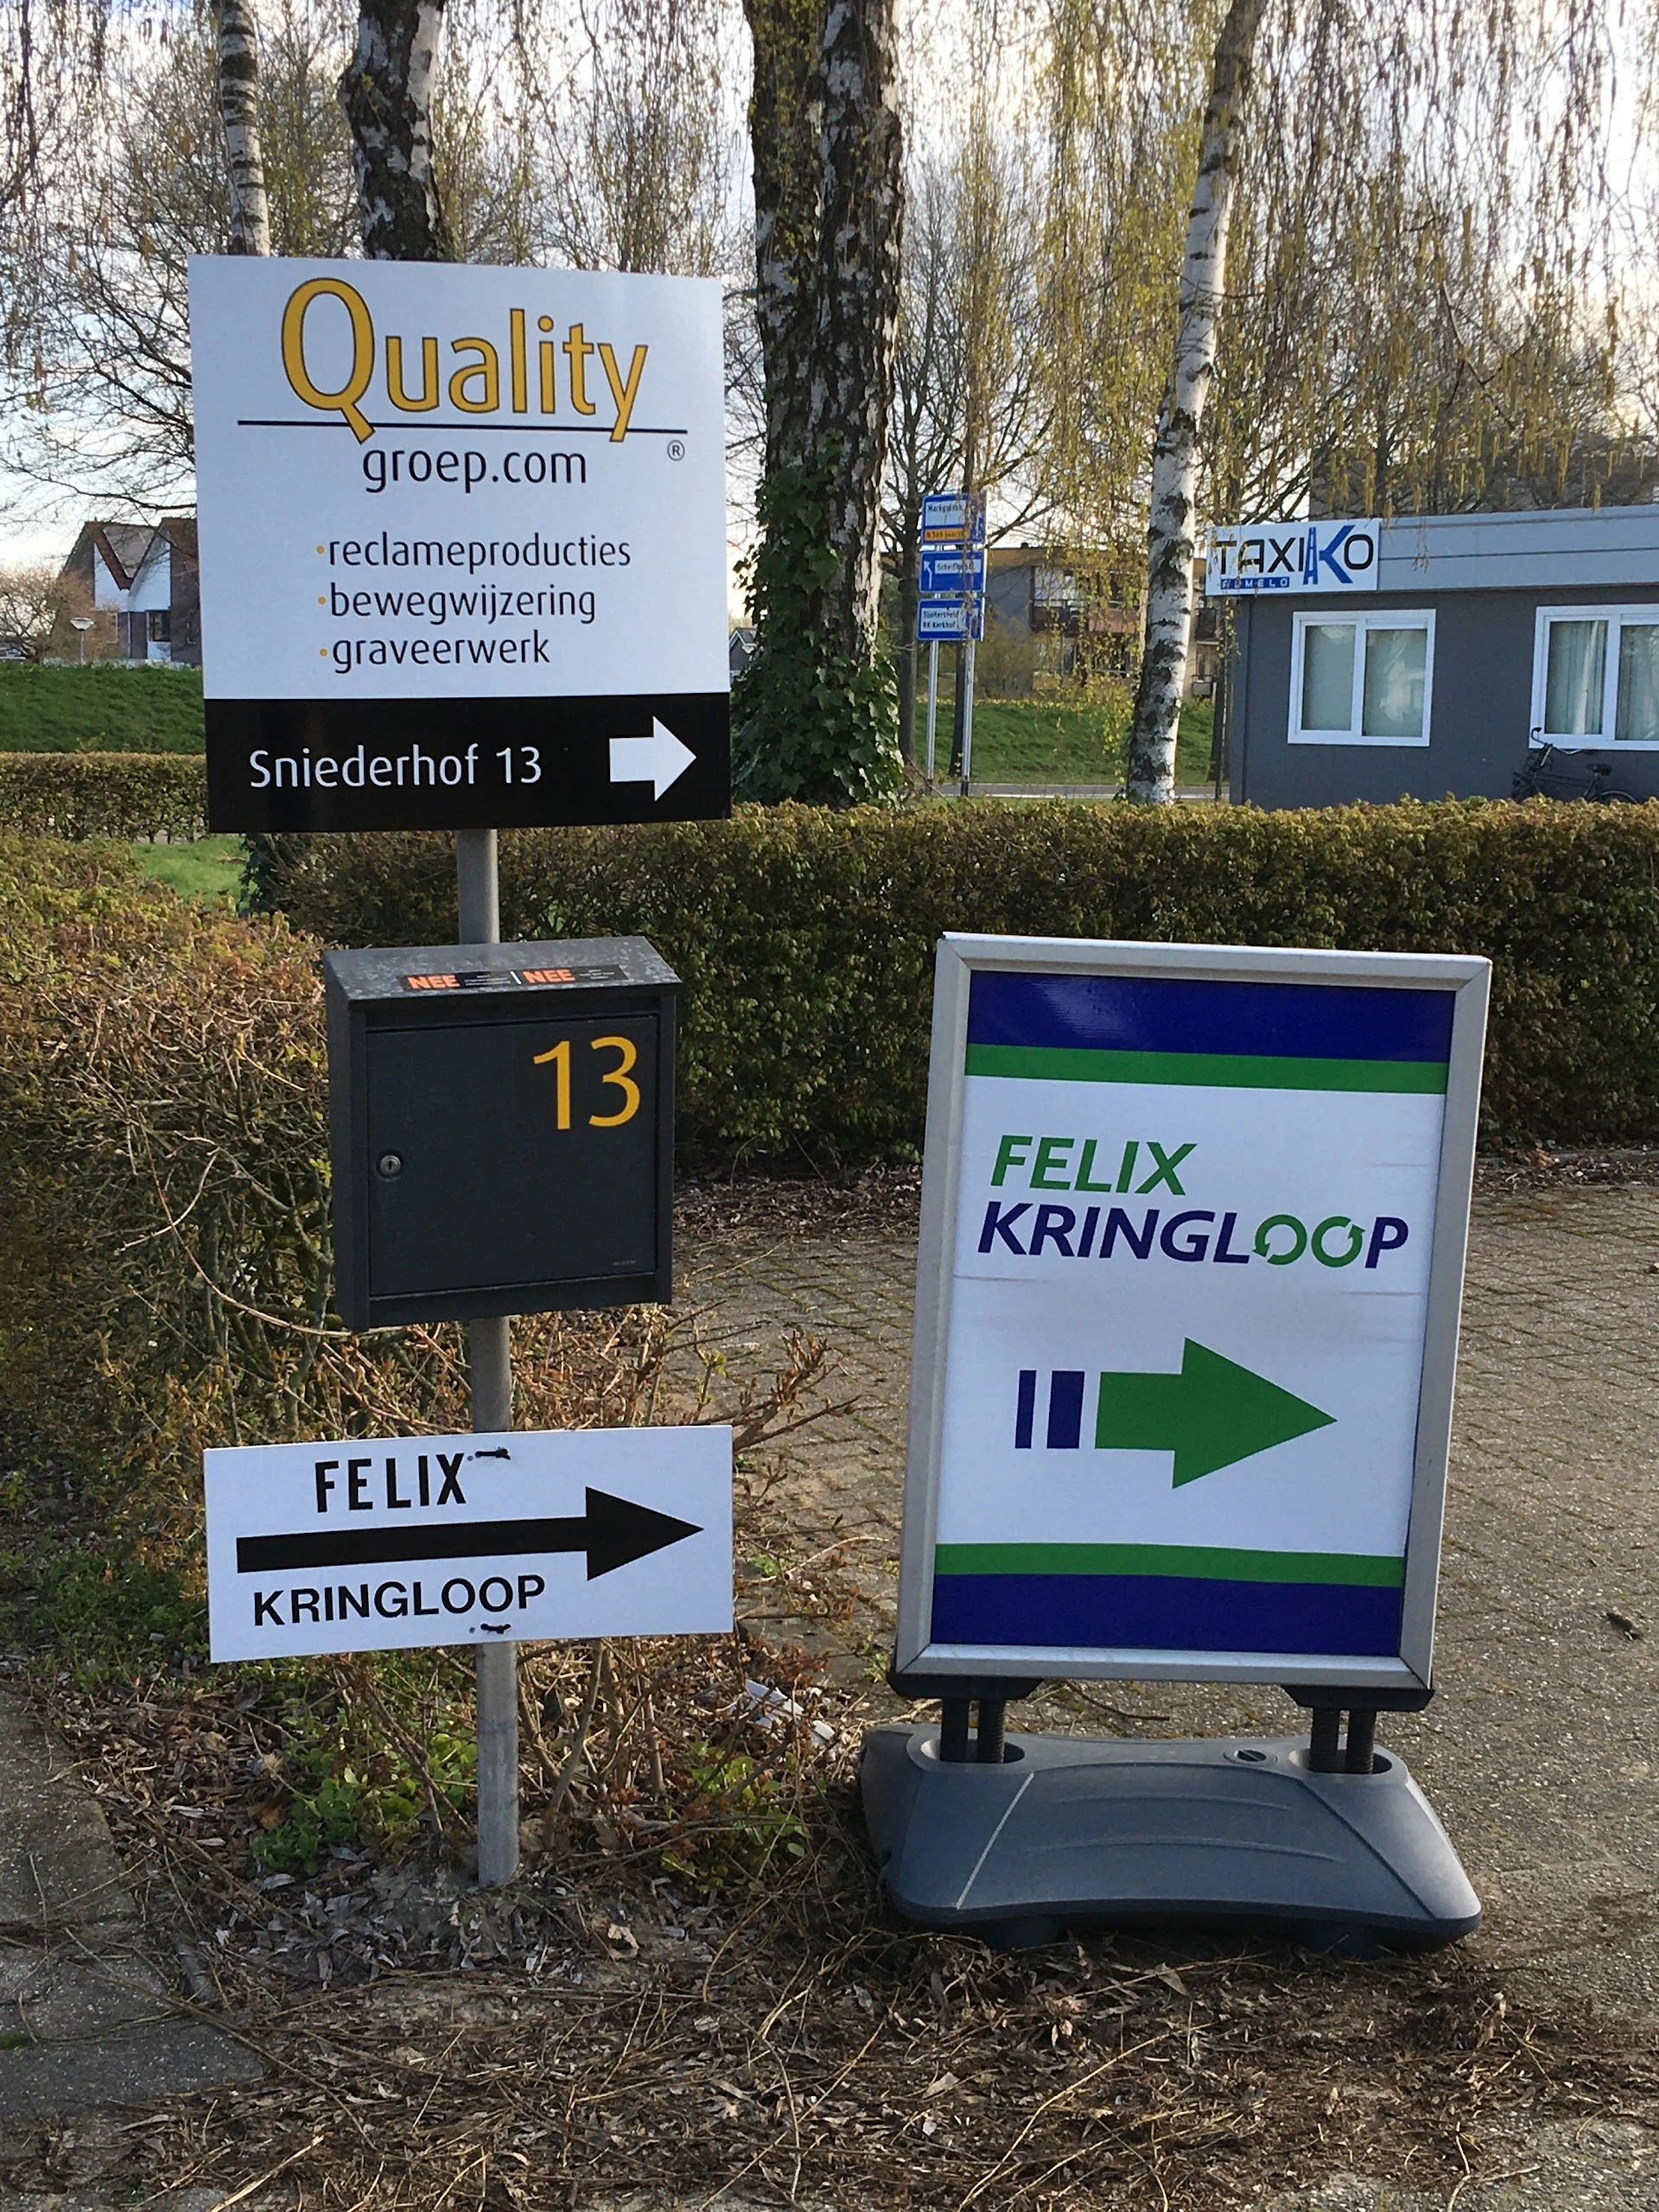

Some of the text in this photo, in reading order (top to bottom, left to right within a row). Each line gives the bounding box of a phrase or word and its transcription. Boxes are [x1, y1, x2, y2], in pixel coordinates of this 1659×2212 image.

[281, 276, 650, 448] Quality
[362, 448, 588, 494] groep.com
[328, 531, 632, 575] reclameproducties
[330, 582, 596, 626] bewegwijzering
[332, 629, 551, 675] graveerwerk
[249, 743, 543, 788] Sniederhof 13
[407, 974, 461, 990] NEE
[522, 969, 576, 984] NEE
[532, 1035, 641, 1131] 13
[990, 1135, 1198, 1196] FELIX
[976, 1200, 1409, 1269] KRINGLOOP
[314, 1452, 467, 1514] FELIX
[253, 1573, 546, 1627] KRINGLOOP
